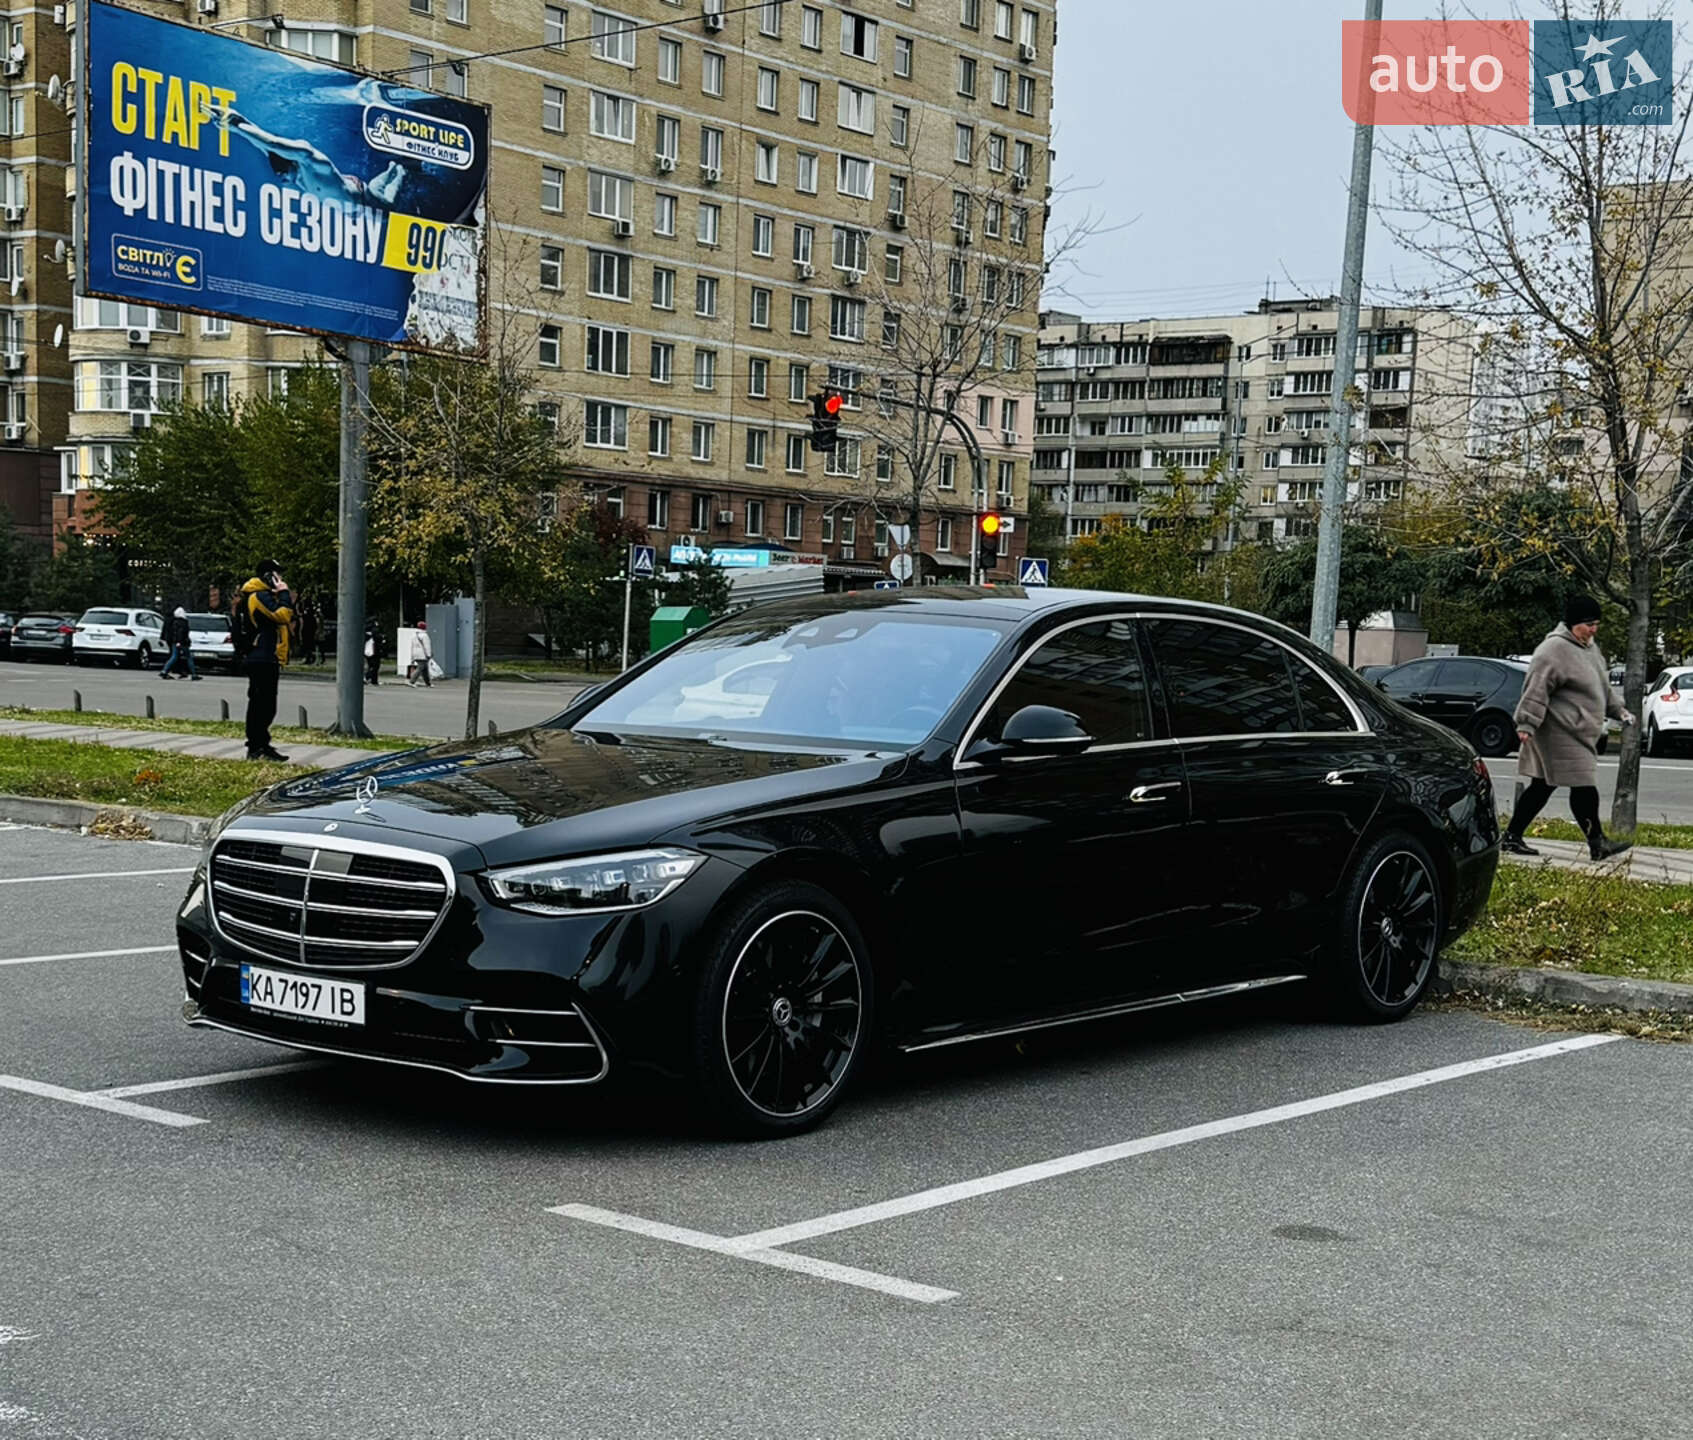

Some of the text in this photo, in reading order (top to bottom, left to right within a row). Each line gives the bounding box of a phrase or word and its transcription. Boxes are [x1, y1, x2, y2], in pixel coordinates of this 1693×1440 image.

[111, 61, 237, 157] СТАРТ
[395, 118, 465, 149] SPORT LIFE
[110, 150, 246, 238] ФІТНЕС
[259, 183, 383, 265] СЕЗОНУ
[176, 255, 197, 284] Є
[331, 985, 356, 1016] IB
